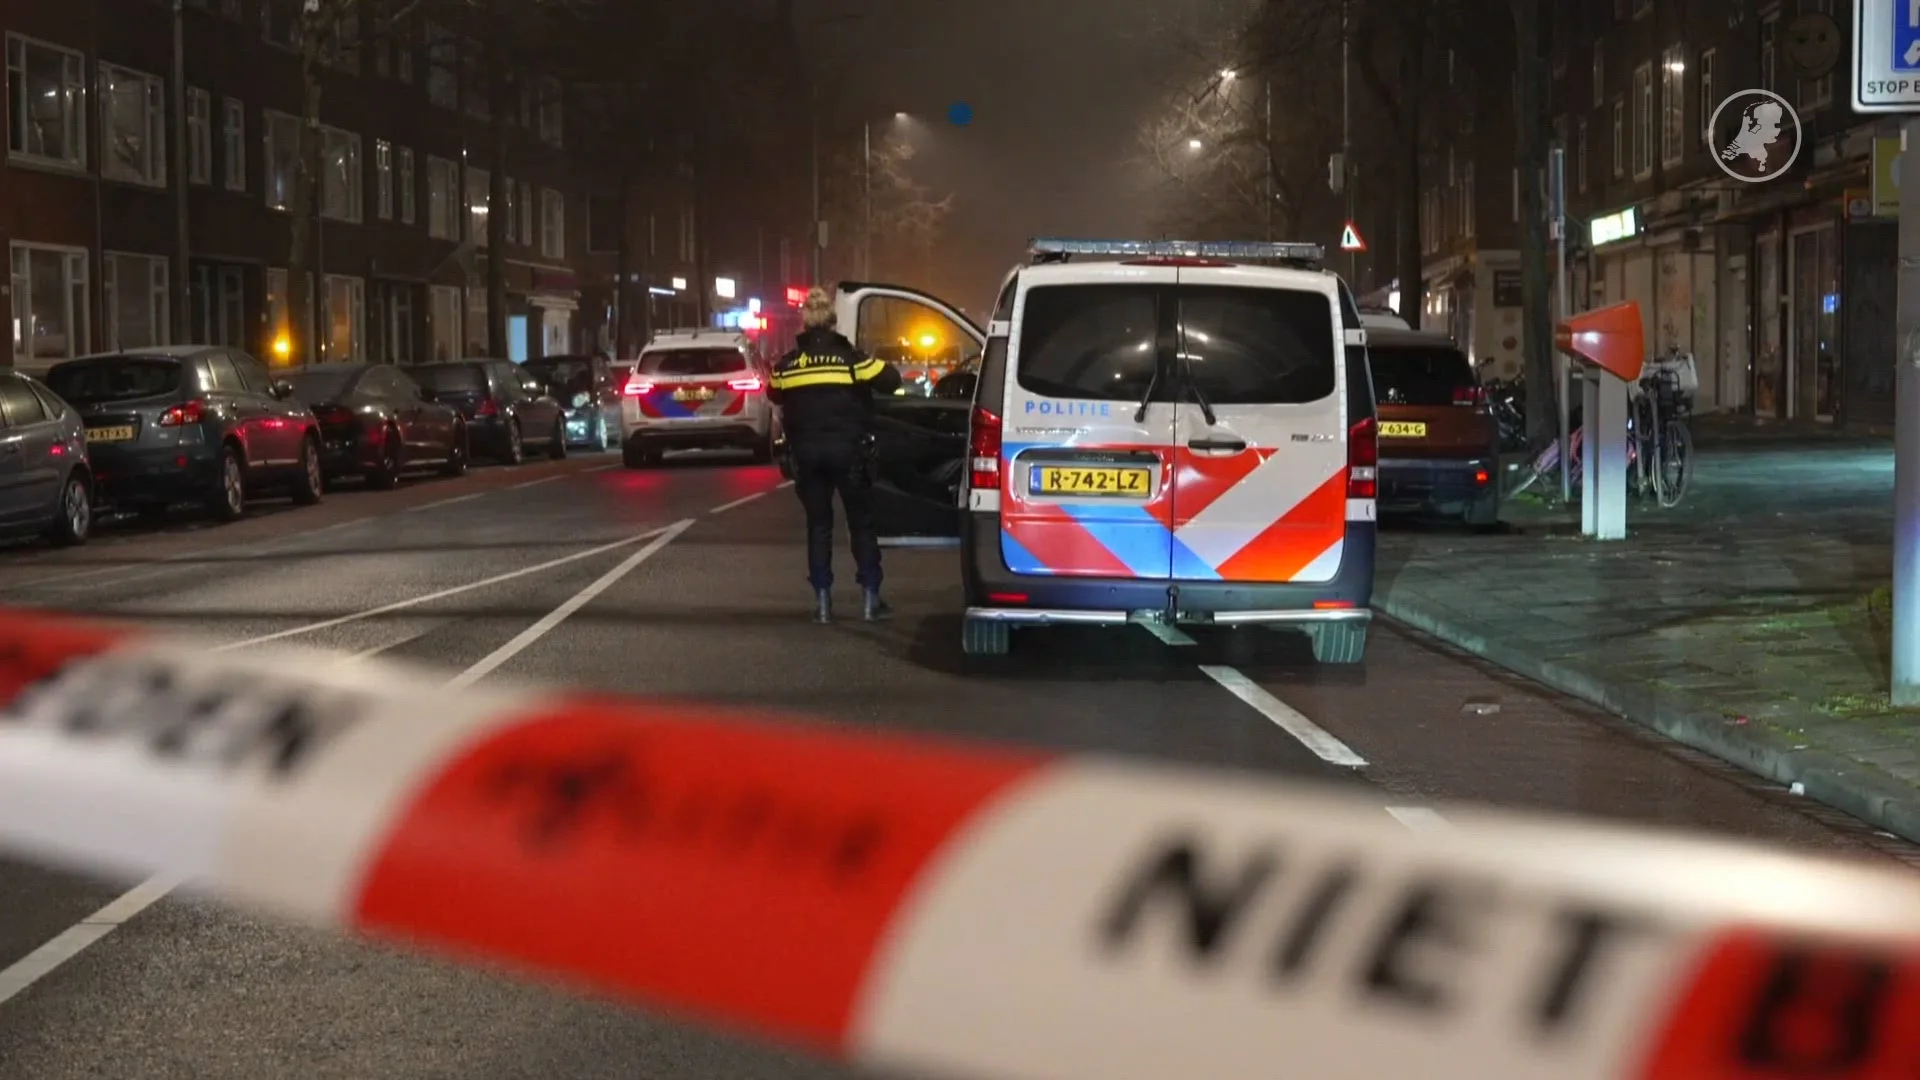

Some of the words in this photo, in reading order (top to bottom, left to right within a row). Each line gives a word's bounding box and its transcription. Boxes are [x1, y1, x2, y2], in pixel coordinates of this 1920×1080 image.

[1867, 80, 1909, 94] STOP
[1025, 400, 1109, 416] POLITIE
[1050, 471, 1139, 490] R-742-LZ
[1097, 824, 1675, 1042] NIET
